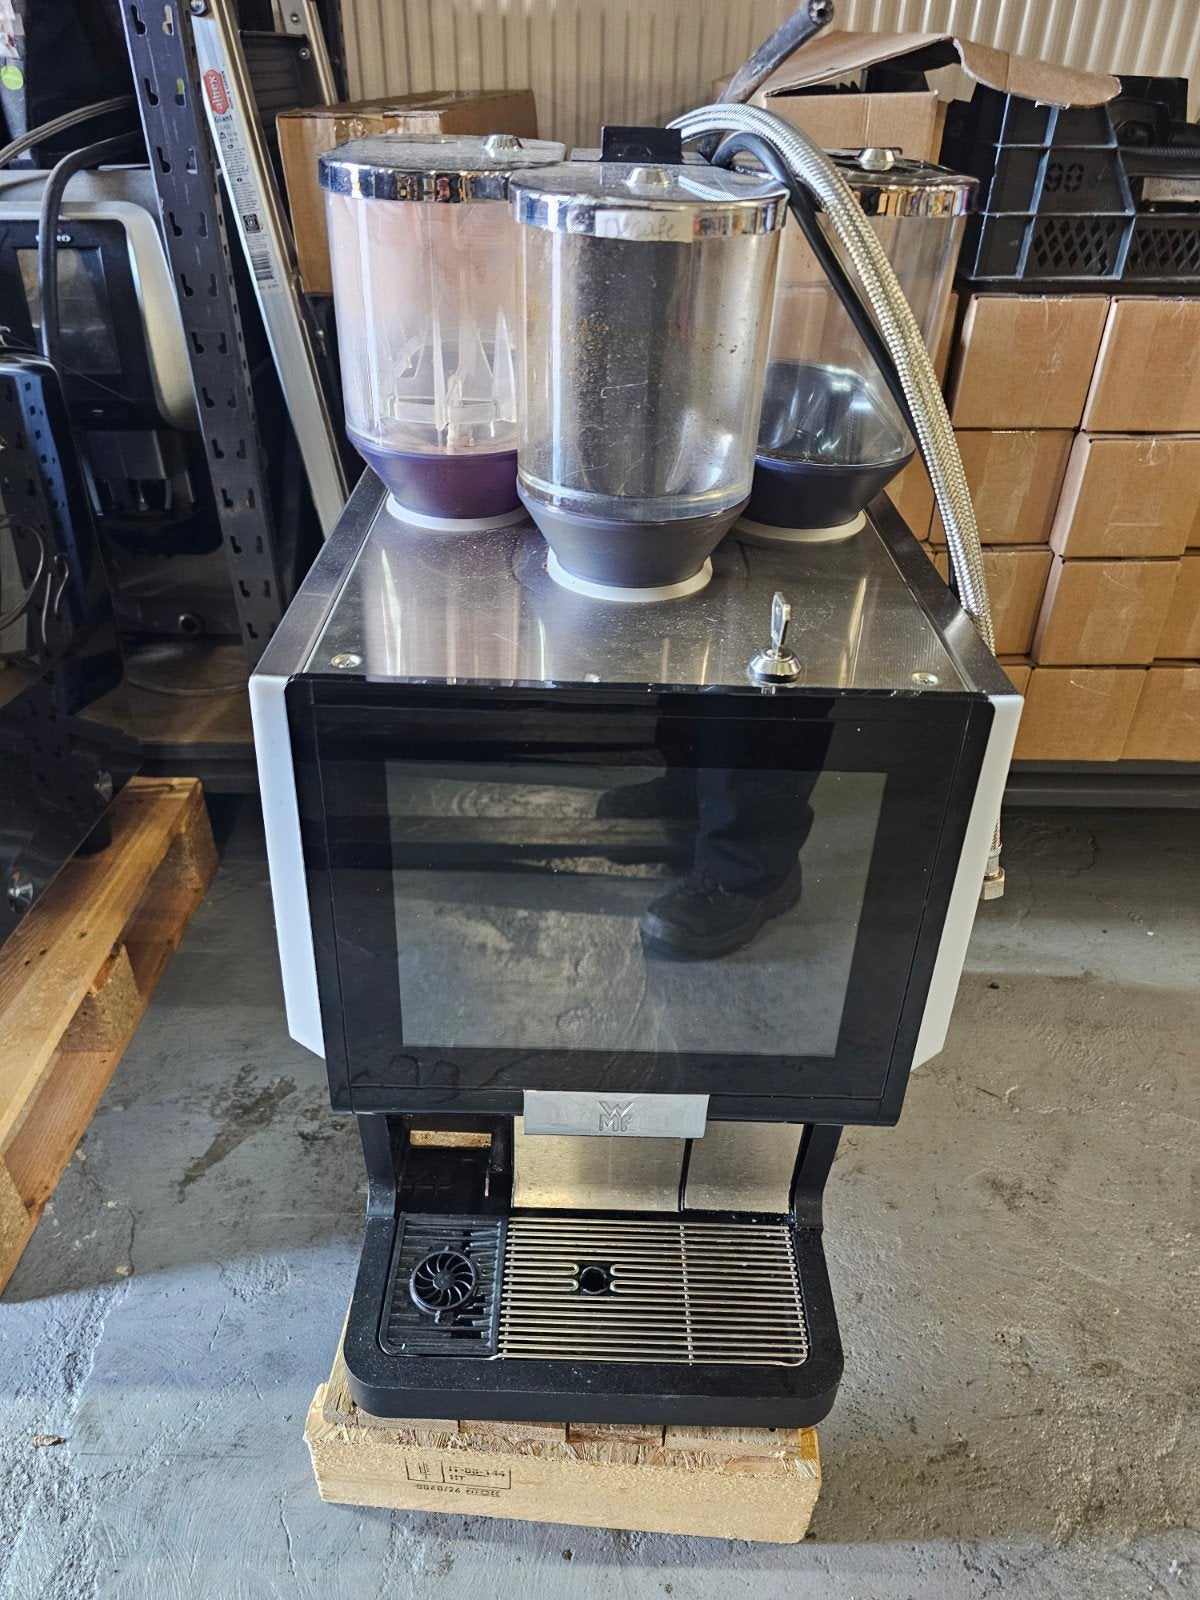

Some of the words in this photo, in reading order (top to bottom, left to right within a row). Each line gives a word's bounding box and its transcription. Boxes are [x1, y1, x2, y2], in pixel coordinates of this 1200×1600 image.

[209, 75, 224, 110] altrex
[214, 114, 233, 123] Giant
[598, 1100, 635, 1133] WMF
